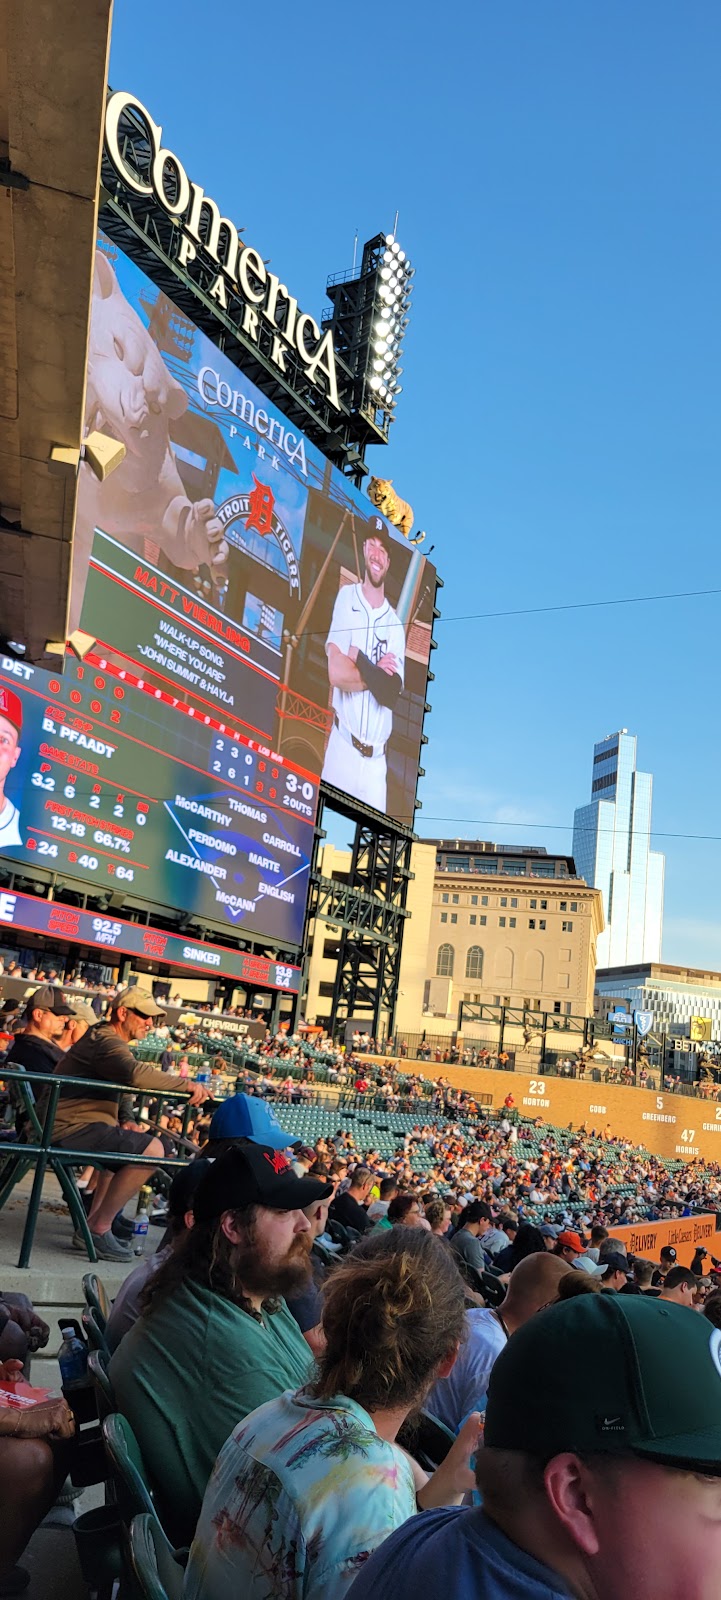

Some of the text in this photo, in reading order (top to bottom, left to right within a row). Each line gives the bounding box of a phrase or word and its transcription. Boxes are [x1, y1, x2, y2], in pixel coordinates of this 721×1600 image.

[177, 233, 287, 373] PARK
[229, 425, 280, 472] PARK
[217, 498, 300, 589] TROIT TIGERS
[134, 566, 250, 653] MATT VIERLING
[159, 619, 225, 668] WALK-UP SONG:
[187, 654, 208, 673] YOU
[118, 670, 126, 680] 4
[165, 659, 201, 685] SUMMIT
[199, 678, 208, 690] &
[206, 682, 235, 706] HAYLA
[2, 657, 35, 680] DET
[110, 709, 121, 724] 2
[213, 760, 222, 772] 2
[228, 767, 236, 779] 6
[243, 775, 250, 786] 1
[42, 717, 116, 759] B. PFAADT
[76, 666, 85, 680] 1
[215, 739, 224, 752] 2
[230, 746, 239, 759] 3
[244, 754, 253, 766] 0
[285, 773, 314, 801] 3-0
[39, 742, 100, 776] GAME STATS
[66, 773, 77, 785] H
[31, 772, 147, 826] 3.2 6 2 2 0
[282, 794, 313, 817] 2 OUTS
[174, 794, 233, 827] McCARTHY
[227, 797, 268, 824] THOMAS
[50, 815, 131, 854] 12-18 66.7%
[188, 828, 238, 857] PERDOMO
[262, 832, 302, 858] CARROLL
[37, 841, 59, 858] 24
[78, 854, 99, 871] 40
[115, 865, 135, 882] 64
[165, 849, 227, 880] ALEXANDER
[248, 851, 281, 874] MARTE
[215, 889, 256, 913] McCANN
[258, 882, 295, 904] ENGLISH
[49, 908, 80, 924] PITCH
[92, 917, 122, 936] 92.5
[47, 919, 80, 936] SPEED
[94, 931, 116, 945] MPH
[142, 931, 168, 947] PITCH
[143, 942, 166, 957] TYPE
[183, 946, 221, 967] SINKER
[275, 964, 293, 979] 13.8
[275, 975, 291, 988] 5.4
[202, 1017, 250, 1035] CHEVROLET
[528, 1080, 546, 1095] 23
[522, 1096, 550, 1108] HORTON
[589, 1104, 607, 1115] COBB
[656, 1096, 664, 1110] 5
[642, 1112, 677, 1124] GREENBERG
[702, 1122, 721, 1132] GEHRI
[680, 1129, 696, 1143] 47
[675, 1145, 700, 1155] MORRIS
